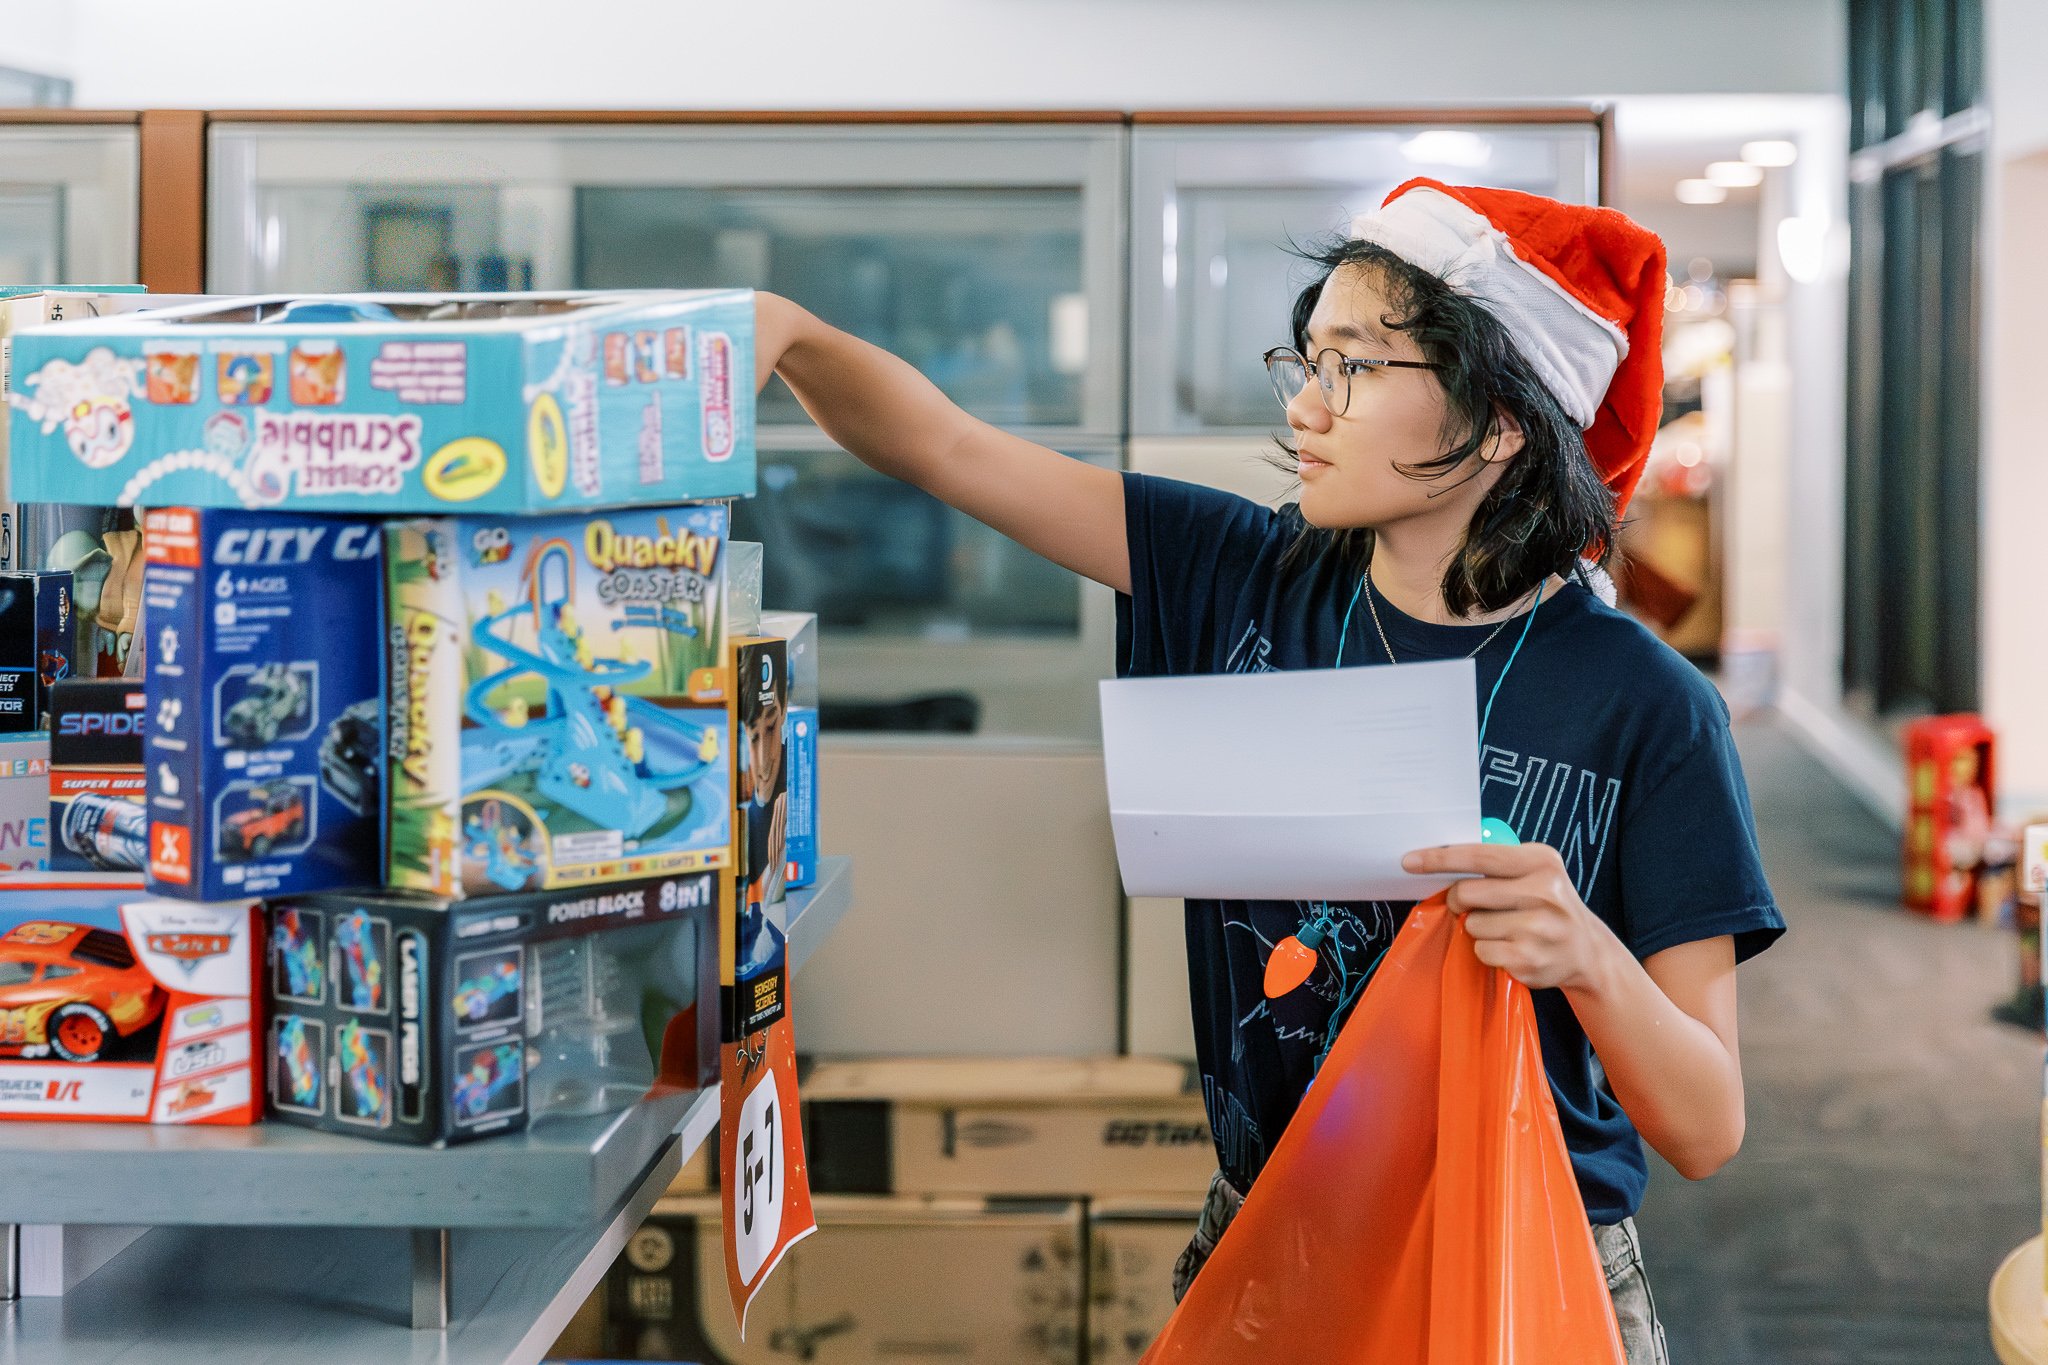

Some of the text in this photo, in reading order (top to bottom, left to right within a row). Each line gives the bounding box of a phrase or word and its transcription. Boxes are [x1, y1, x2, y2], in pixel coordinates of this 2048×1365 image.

[51, 304, 64, 321] 5+
[262, 421, 414, 463] Scrubbie
[213, 527, 326, 564] CITY
[585, 519, 719, 577] Quacky
[62, 780, 110, 788] SUPER
[549, 899, 597, 923] POWER
[598, 892, 645, 914] BLOCK
